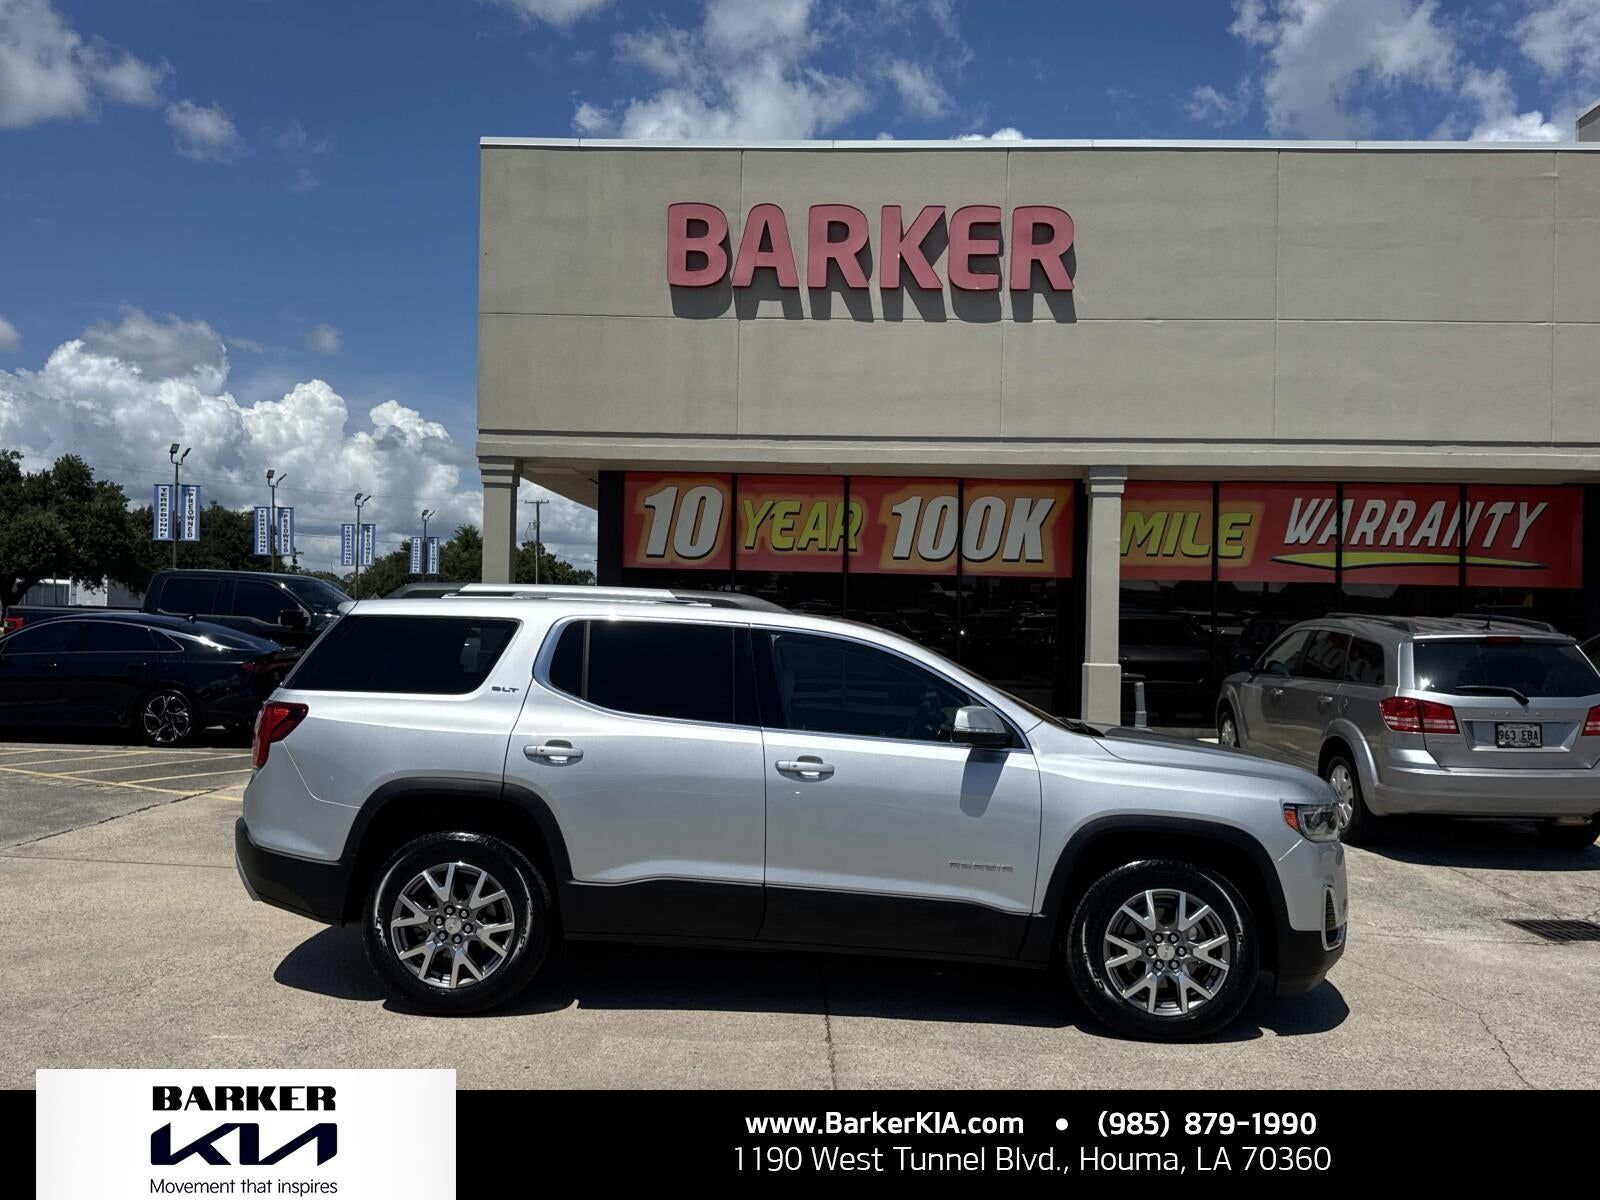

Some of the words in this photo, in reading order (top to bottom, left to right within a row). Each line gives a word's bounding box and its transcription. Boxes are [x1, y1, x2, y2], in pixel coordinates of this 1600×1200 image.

[667, 203, 1075, 292] BARKER
[160, 487, 168, 538] TERREBONNE
[186, 492, 195, 538] PREOWNED
[644, 485, 724, 559] 10
[743, 498, 864, 552] YEAR
[891, 495, 1057, 563] 100K
[1120, 511, 1253, 560] MILE
[1283, 497, 1549, 550] WARRANTY
[1498, 730, 1516, 740] 963
[1521, 730, 1539, 741] EBA
